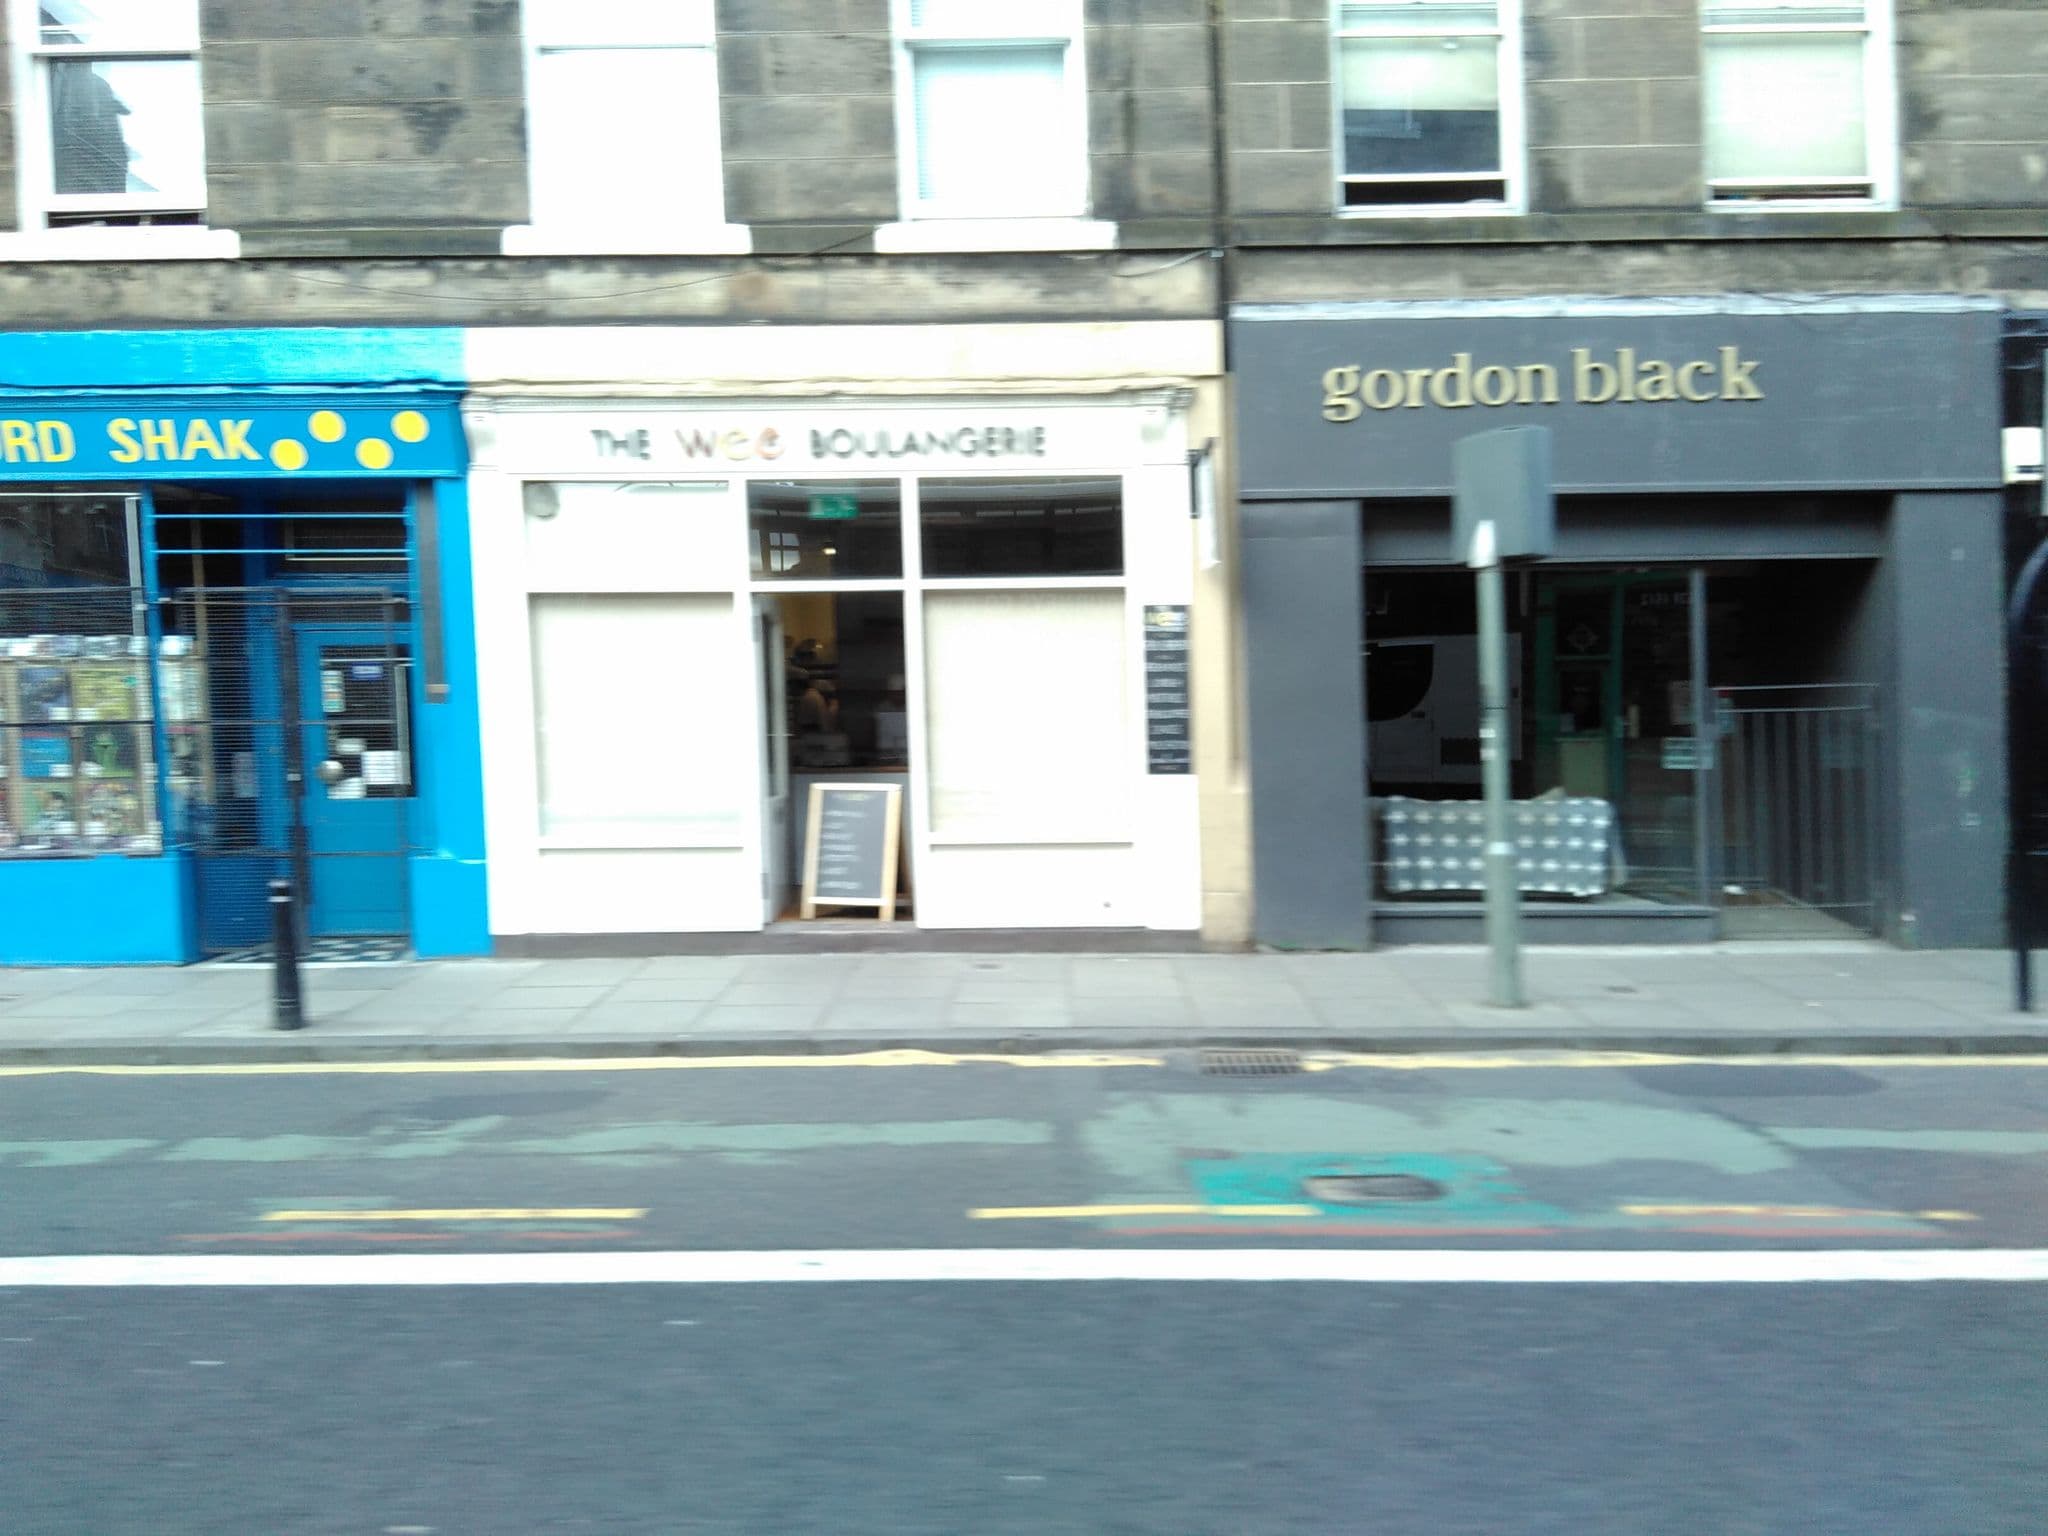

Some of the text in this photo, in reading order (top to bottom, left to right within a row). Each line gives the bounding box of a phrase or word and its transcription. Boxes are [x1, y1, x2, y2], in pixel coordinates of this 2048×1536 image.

[1321, 346, 1765, 423] gordon black
[0, 418, 263, 463] RD SHAK
[591, 428, 651, 460] THE
[810, 426, 1046, 459] BOULANGERIE
